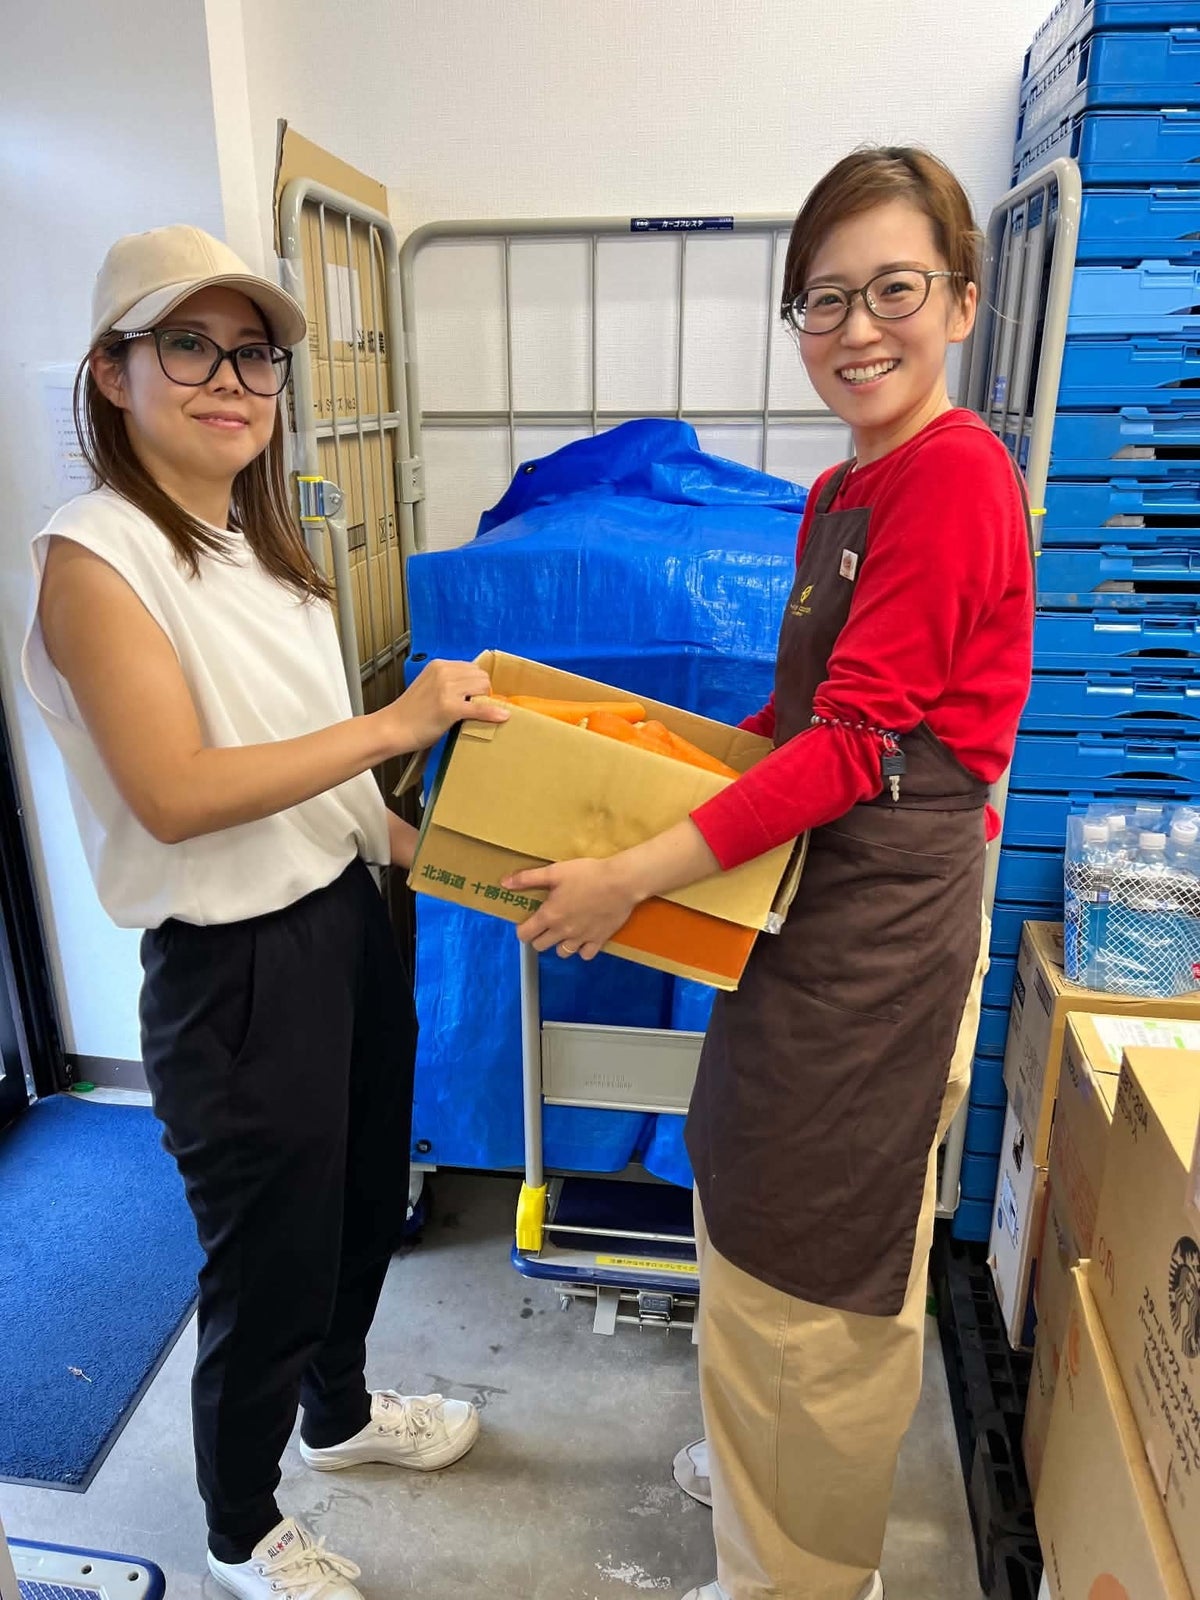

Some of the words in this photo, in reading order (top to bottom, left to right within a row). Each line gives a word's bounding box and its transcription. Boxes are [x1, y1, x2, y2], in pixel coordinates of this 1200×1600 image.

[421, 863, 467, 890] 北海道
[267, 1545, 280, 1559] ALL
[280, 1530, 295, 1546] STAR
